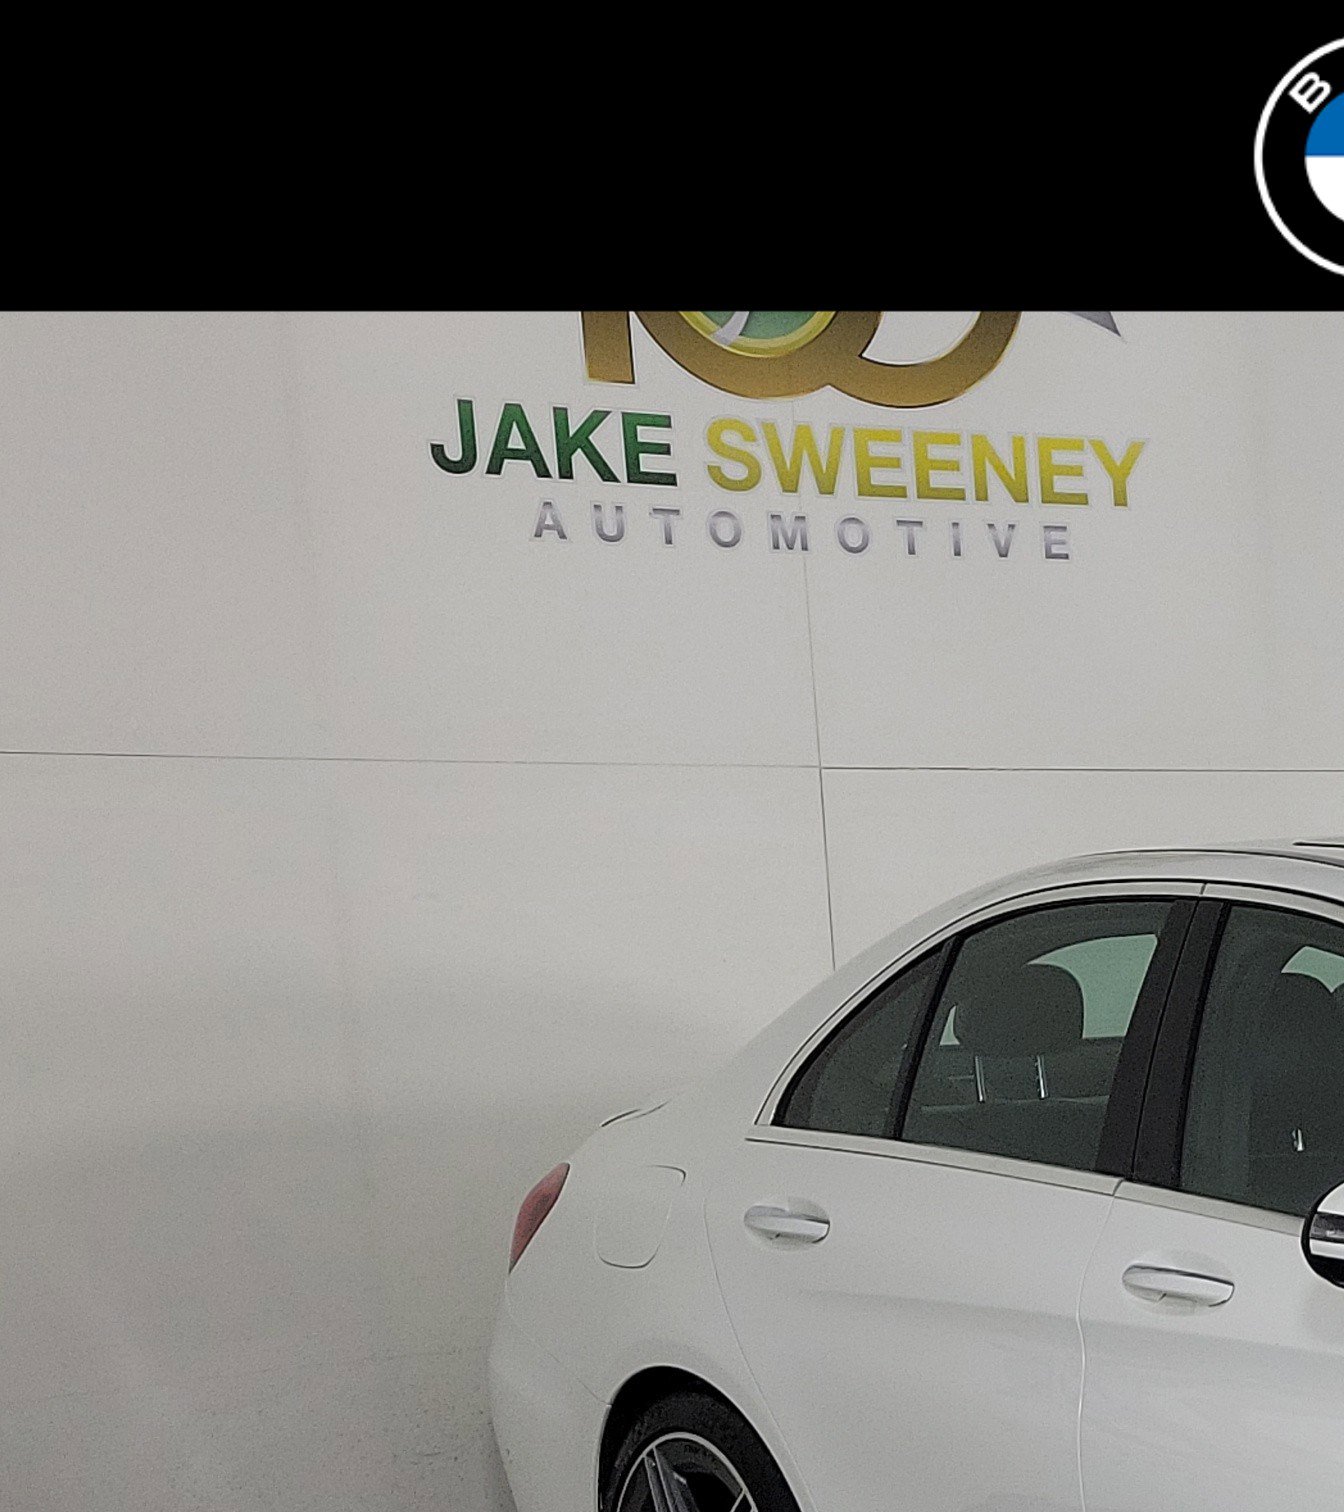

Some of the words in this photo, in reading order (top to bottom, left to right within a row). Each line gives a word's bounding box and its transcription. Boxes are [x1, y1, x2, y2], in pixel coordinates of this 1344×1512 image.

[430, 398, 677, 487] JAKE
[705, 417, 1146, 507] SWEENEY
[533, 501, 1070, 560] AUTOMOTIVE
